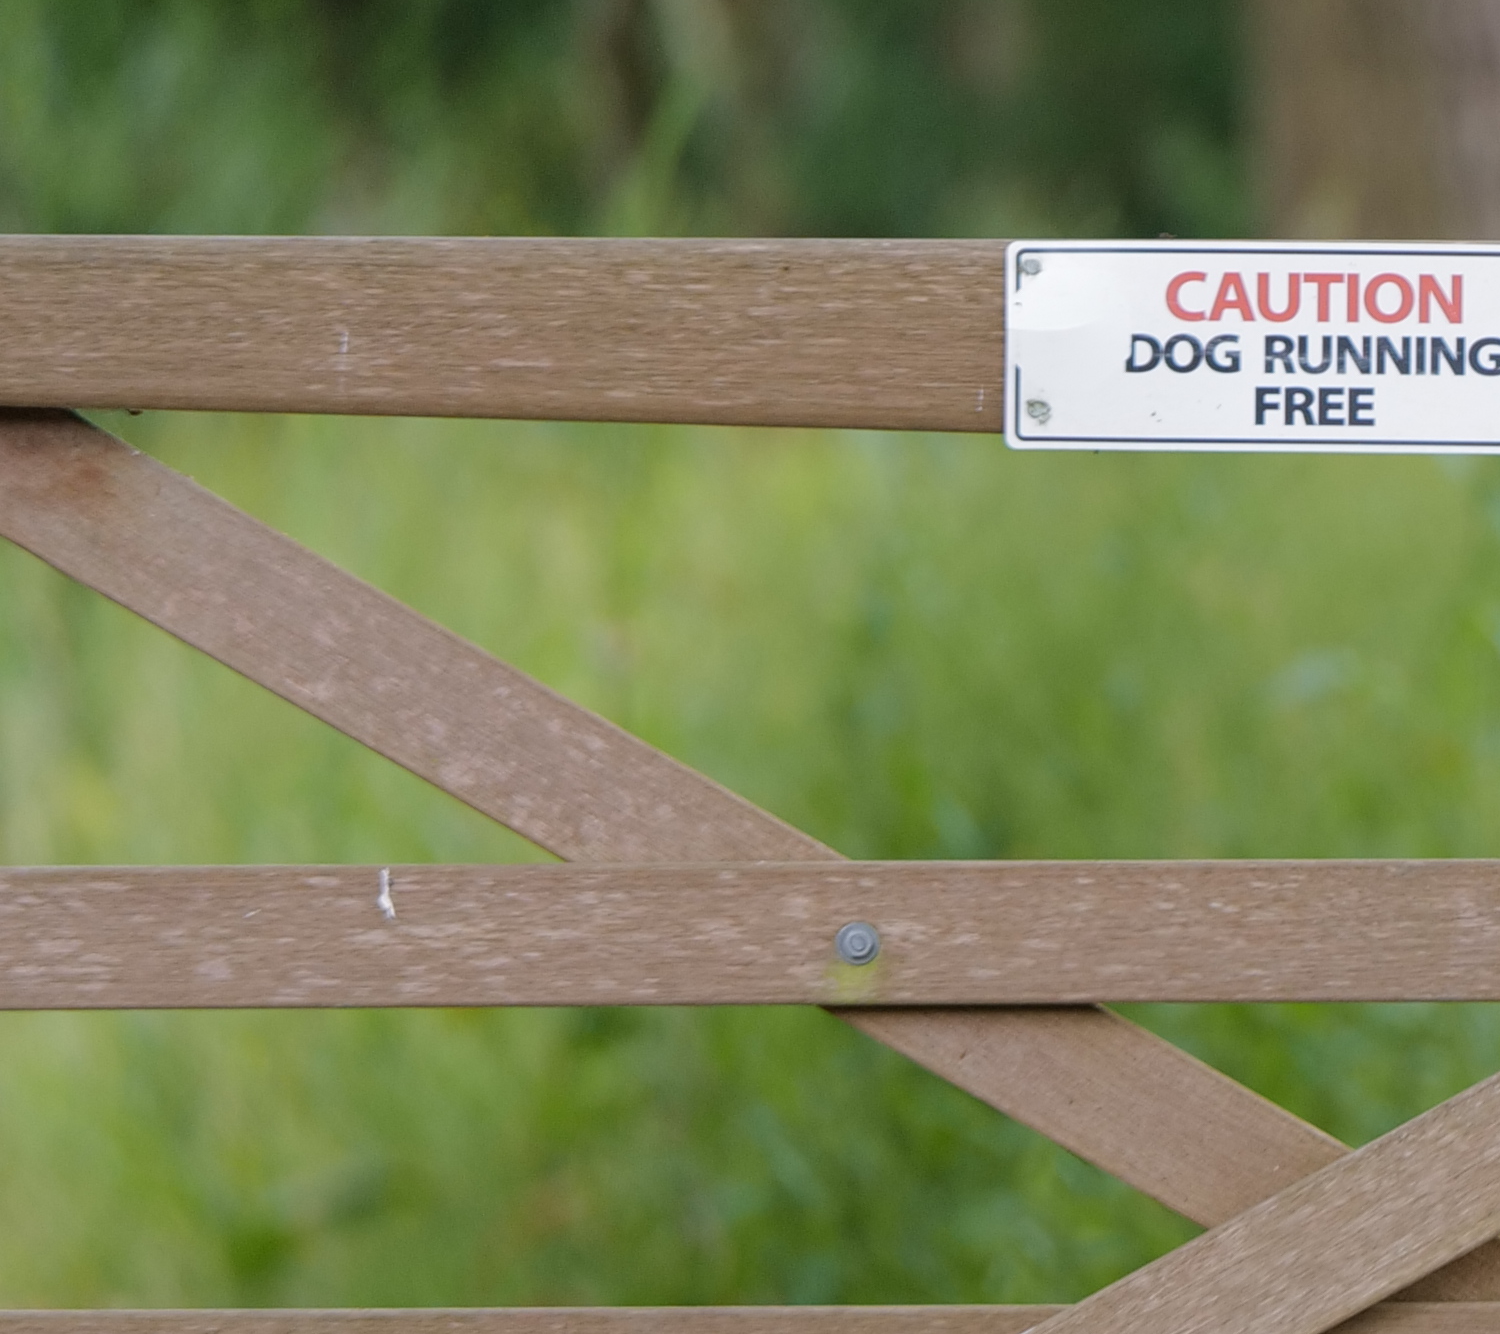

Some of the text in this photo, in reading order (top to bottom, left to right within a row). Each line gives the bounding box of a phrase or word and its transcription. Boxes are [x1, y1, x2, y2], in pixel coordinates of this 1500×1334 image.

[1165, 271, 1463, 325] CAUTION
[1124, 333, 1241, 375] DOG
[1254, 386, 1375, 427] FREE
